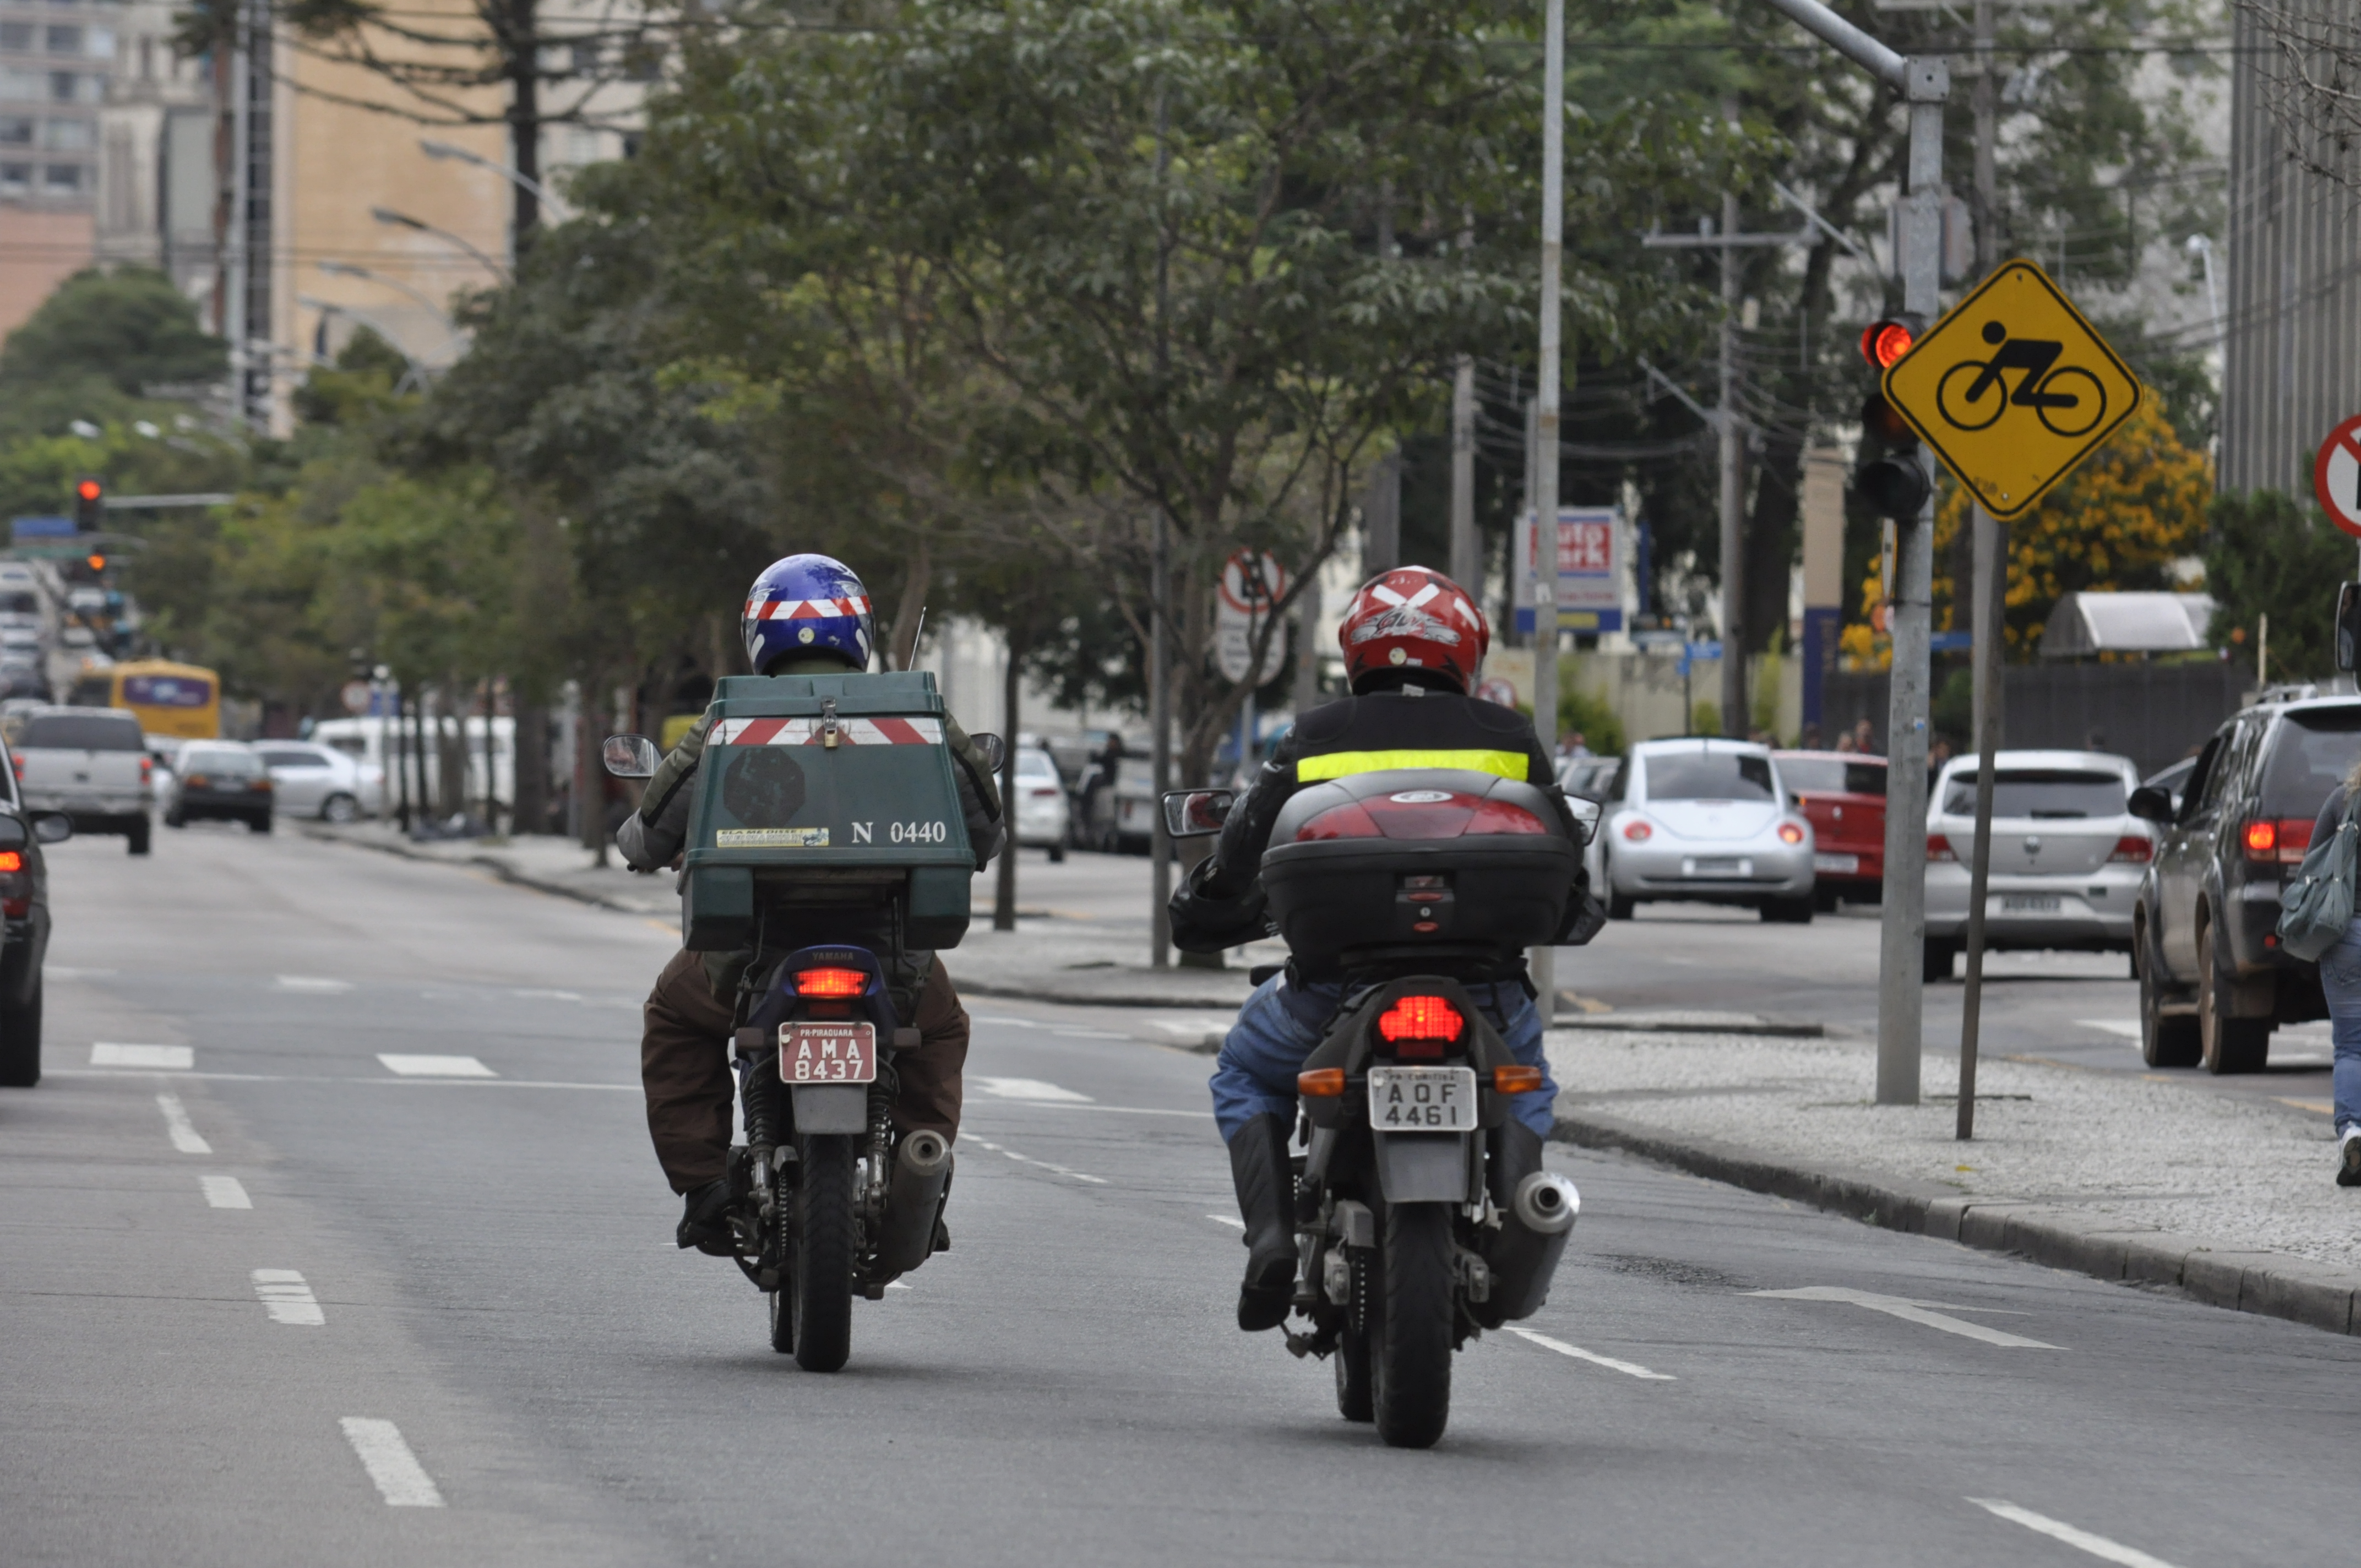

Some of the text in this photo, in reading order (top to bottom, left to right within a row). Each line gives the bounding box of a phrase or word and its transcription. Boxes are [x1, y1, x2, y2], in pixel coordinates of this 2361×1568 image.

[851, 821, 946, 843] N 0440
[795, 1059, 863, 1080] 8437
[1385, 1105, 1456, 1125] 4461
